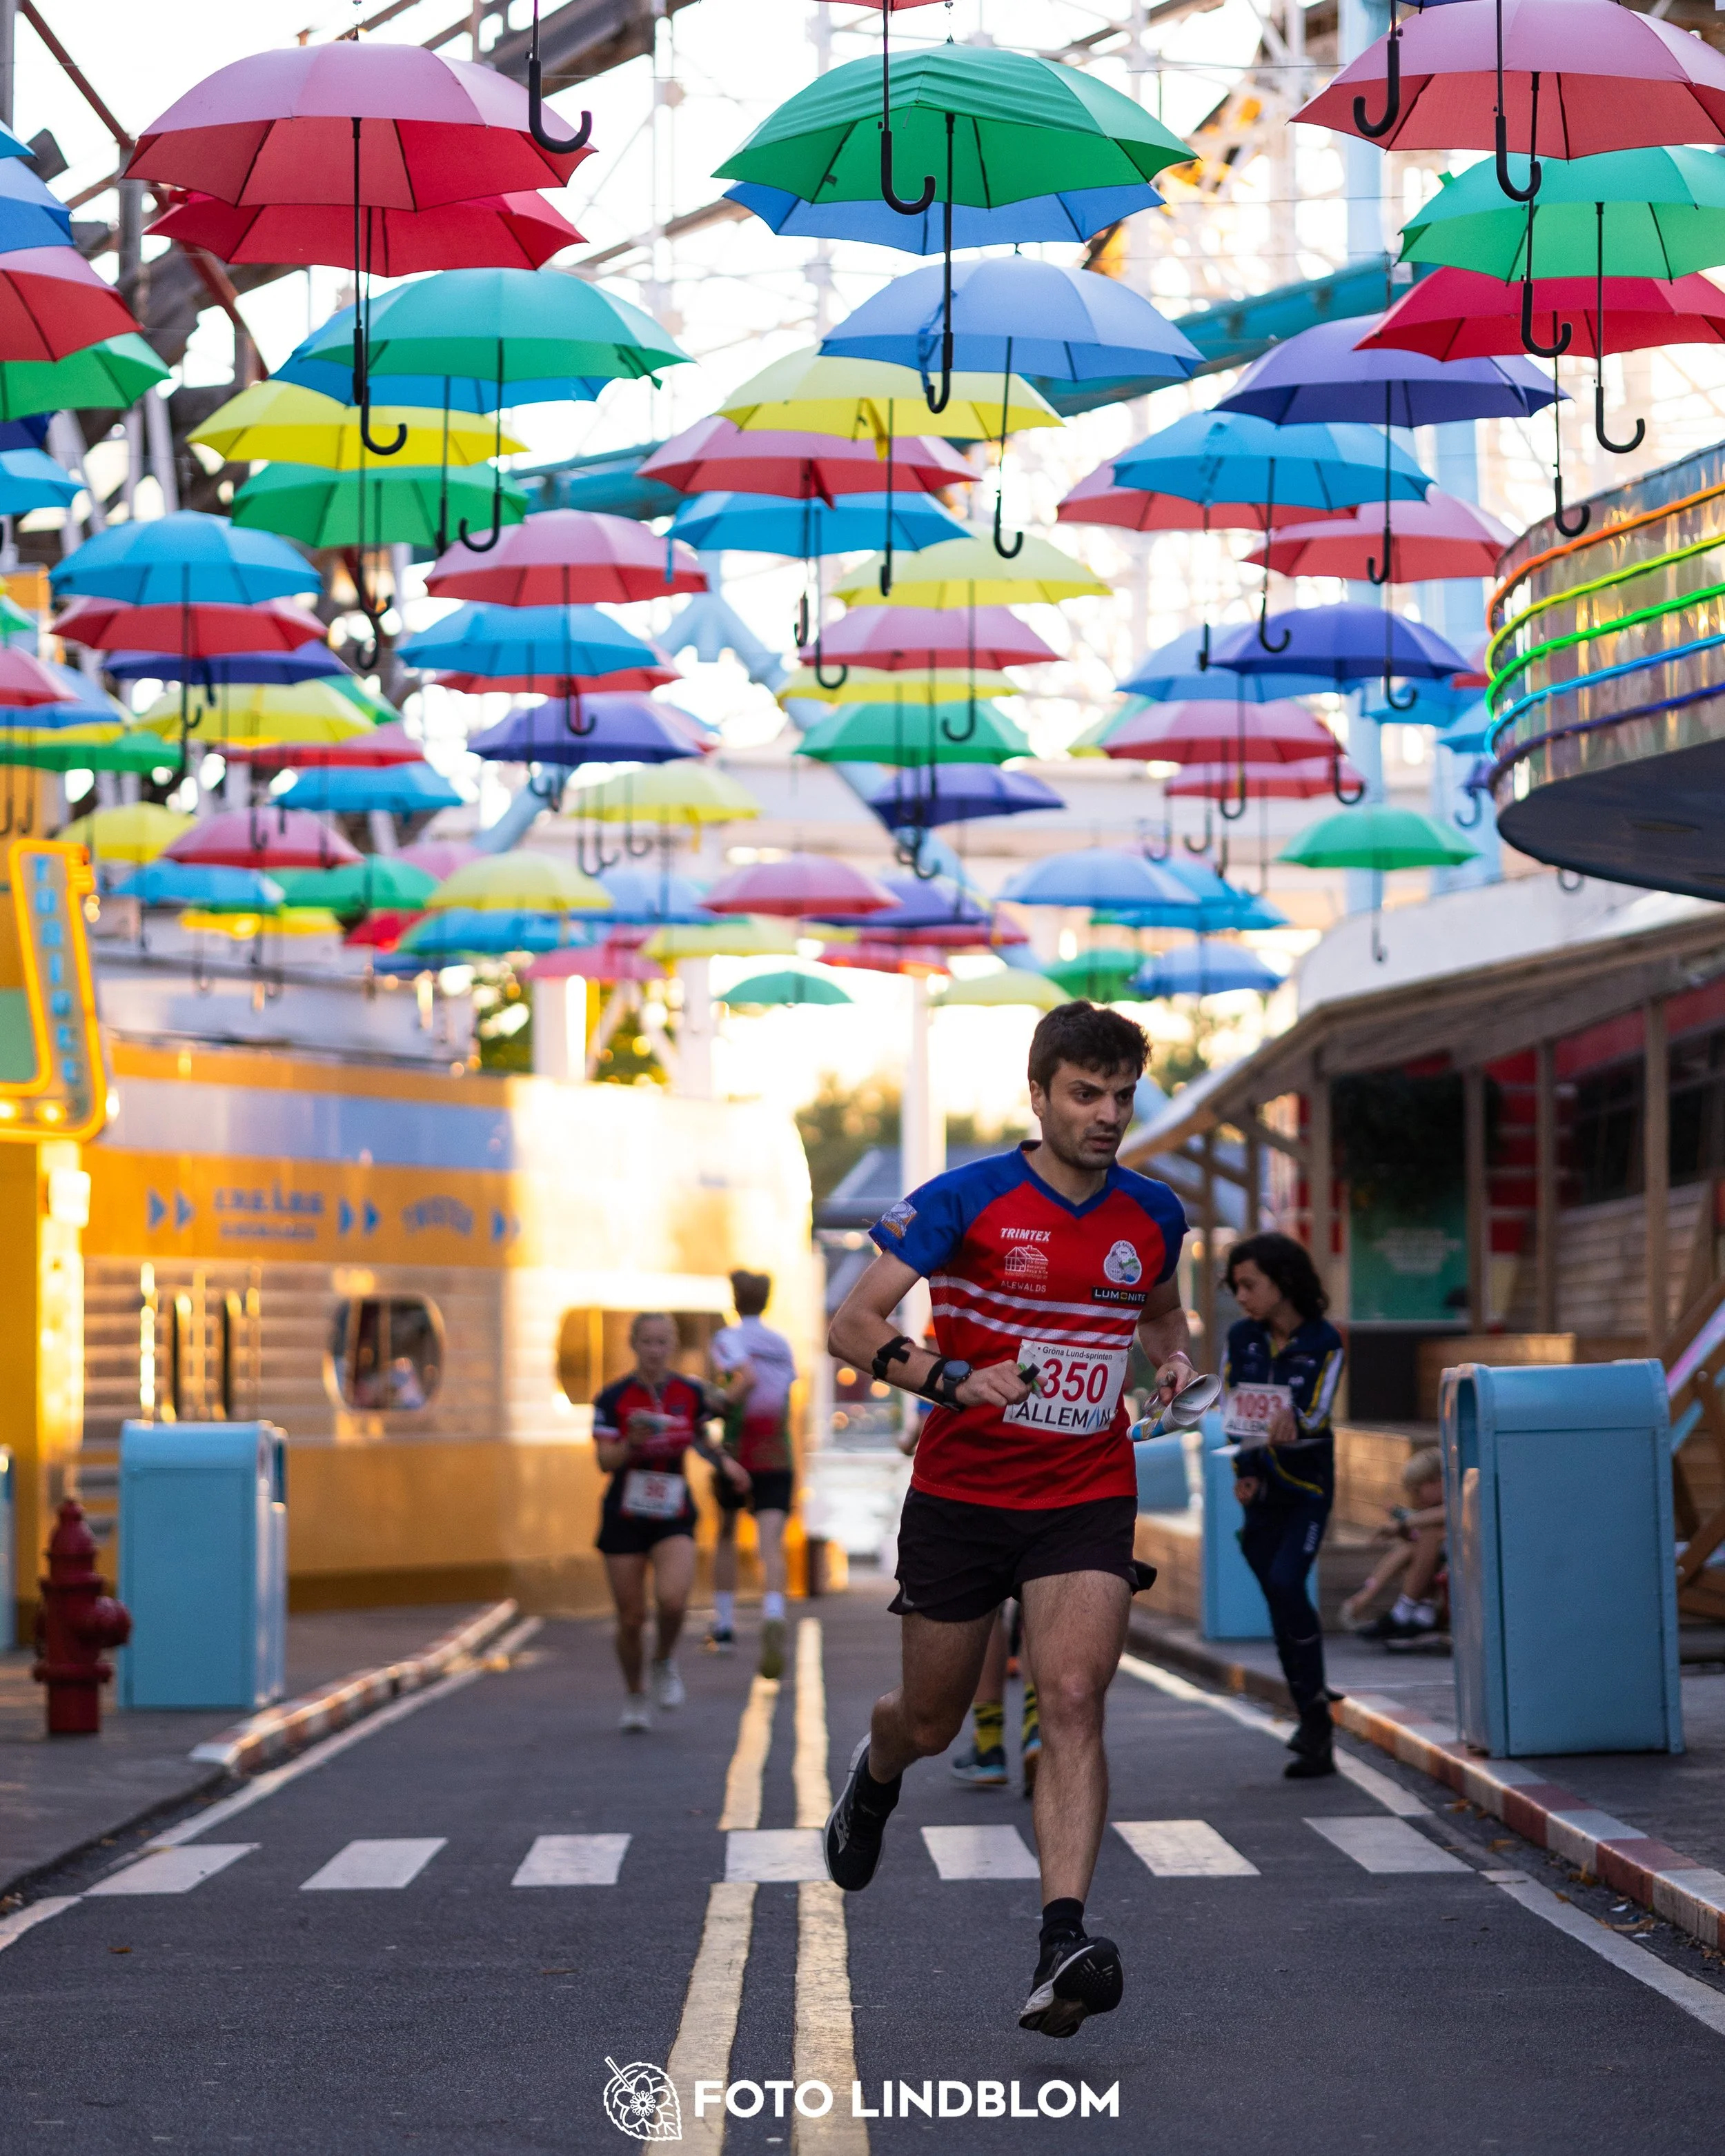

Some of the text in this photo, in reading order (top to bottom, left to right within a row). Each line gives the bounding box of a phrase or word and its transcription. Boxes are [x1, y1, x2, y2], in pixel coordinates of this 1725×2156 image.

[1000, 1227, 1051, 1242] TRIMTEX
[1000, 1280, 1047, 1293] ALEWALDS
[1094, 1289, 1146, 1302] LUMONITE
[1043, 1346, 1113, 1361] Gröna Lund-sprinten
[1041, 1358, 1108, 1404] 350
[1015, 1401, 1111, 1432] ALLEMAN
